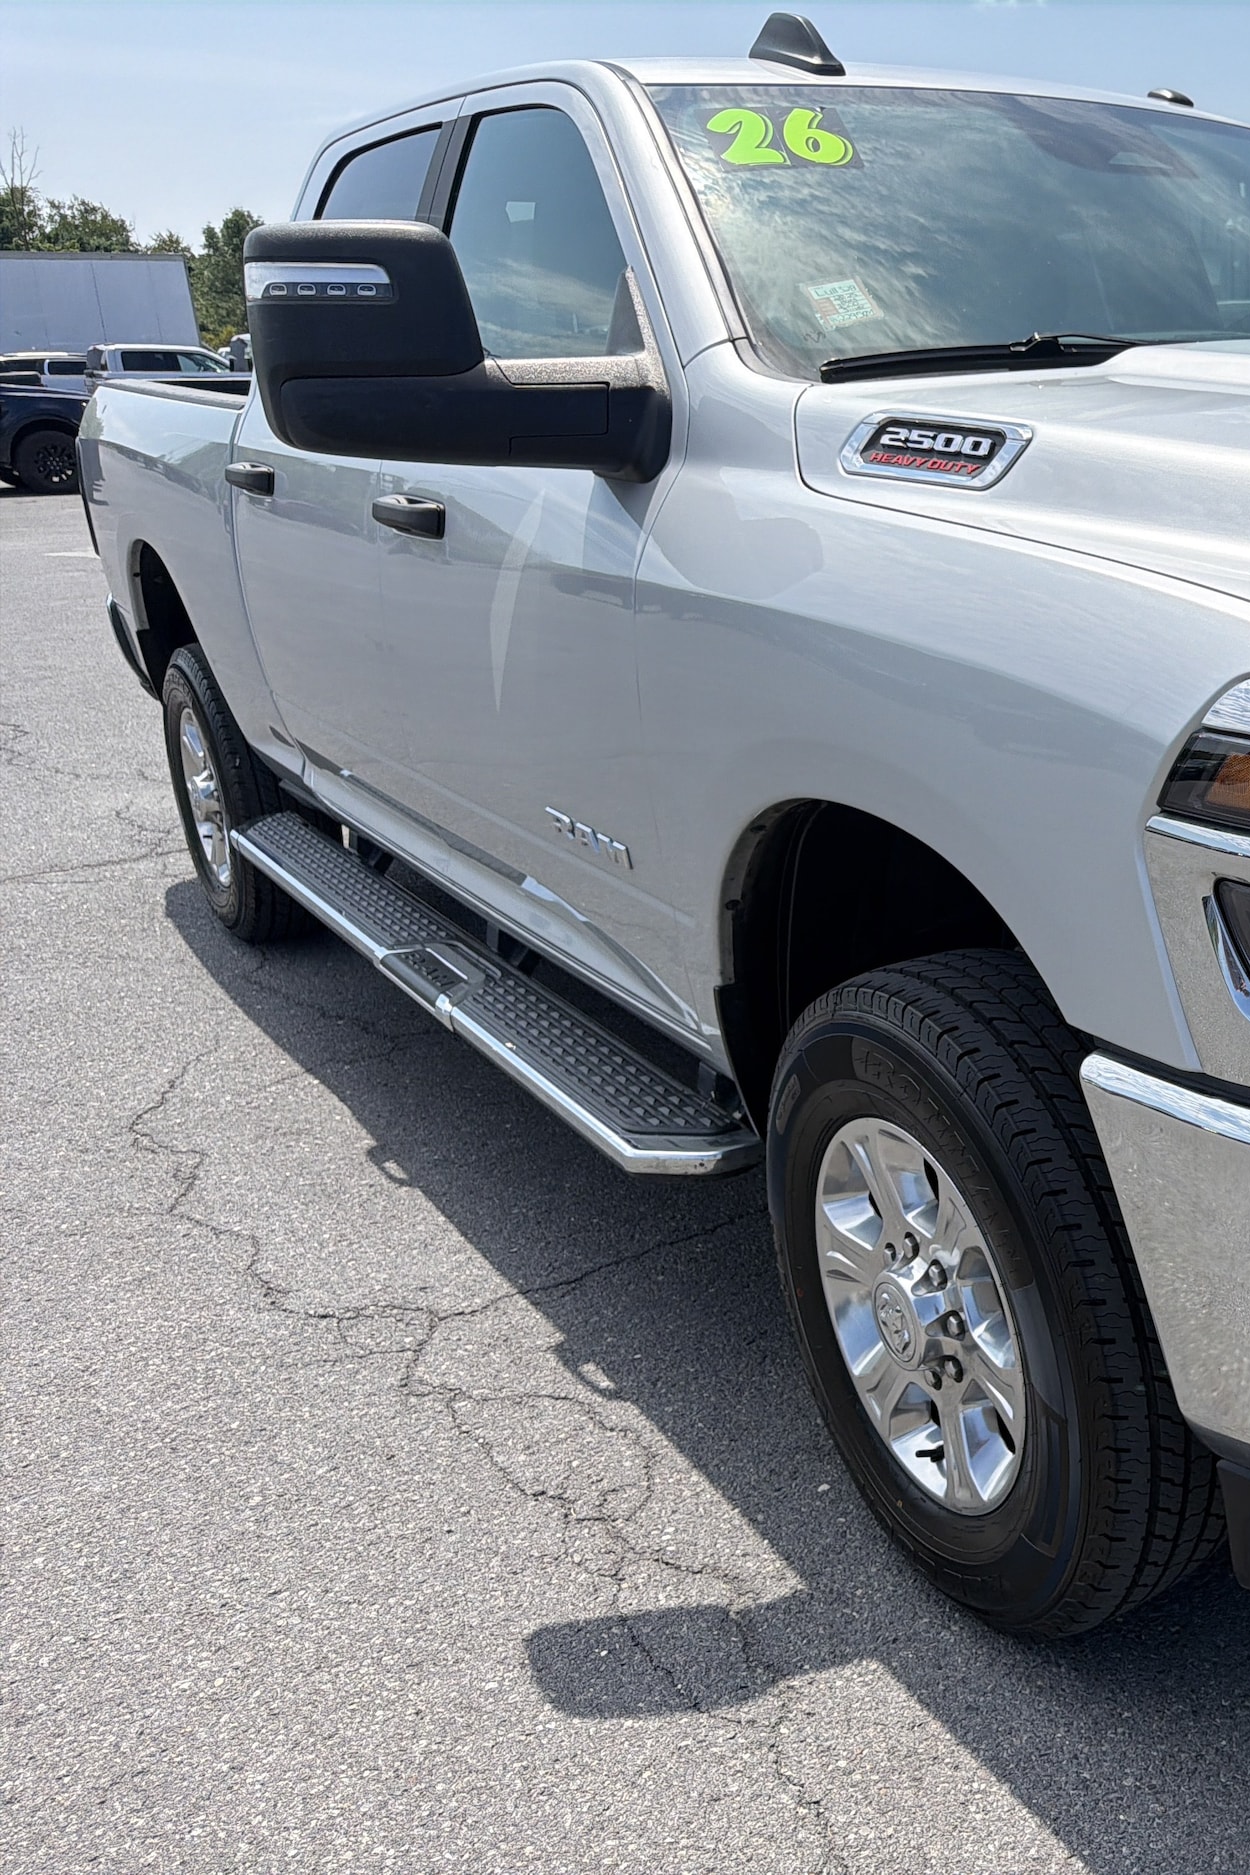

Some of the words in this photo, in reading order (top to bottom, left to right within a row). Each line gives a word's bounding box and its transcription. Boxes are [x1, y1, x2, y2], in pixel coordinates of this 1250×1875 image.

[706, 107, 854, 166] 26
[869, 452, 928, 467] HEAVY
[926, 459, 981, 474] DUTY
[879, 426, 994, 457] 2500
[545, 806, 633, 870] RAM
